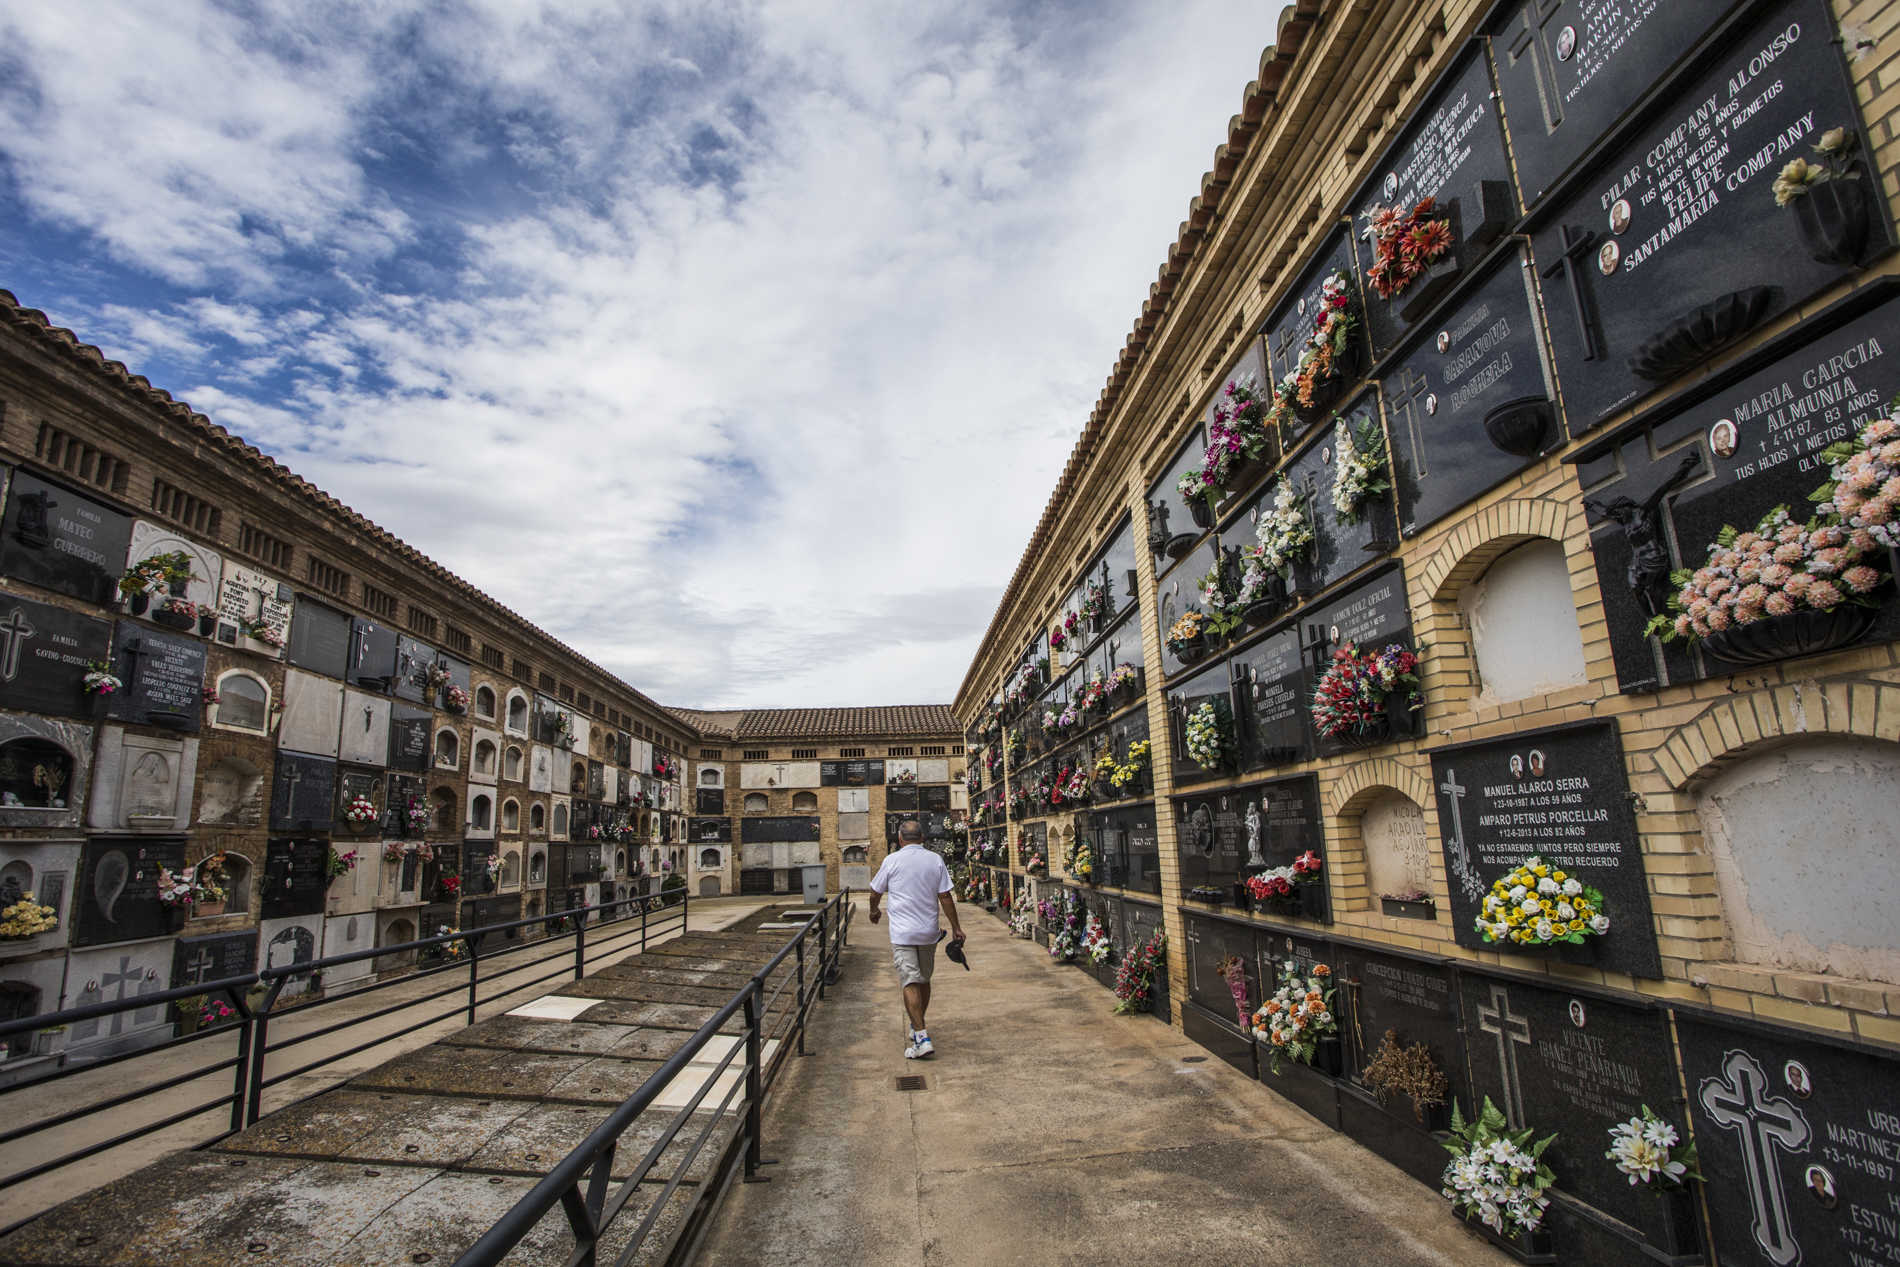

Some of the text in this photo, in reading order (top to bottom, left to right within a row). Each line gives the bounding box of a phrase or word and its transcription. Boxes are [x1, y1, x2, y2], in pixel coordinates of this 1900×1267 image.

[1413, 107, 1445, 154] ANTONIO
[1600, 23, 1800, 210] PILAR COMPANY ALONSO
[1697, 123, 1711, 140] 96
[1399, 133, 1438, 190] ANASTASIO
[1401, 188, 1415, 210] ANA
[1444, 103, 1485, 158] MACHUCA
[1640, 79, 1784, 207] TUS HIJOS NIETOS Y BIZNIETOS
[1624, 110, 1815, 272] SANTAMARIA COMPANY
[1661, 142, 1730, 206] NO TE OLVIDAN
[1667, 162, 1725, 219] FELIPE
[1443, 317, 1511, 384] CASANOVA
[1734, 337, 1883, 425] MARIA GARCIA
[1767, 376, 1858, 433] ALMUNIA
[1824, 406, 1841, 424] 83
[1847, 389, 1880, 414] AÑOS
[1735, 463, 1755, 481] TUS
[1758, 448, 1789, 471] HIJOS
[1793, 442, 1800, 455] Y
[1806, 423, 1847, 450] NIETOS
[54, 537, 106, 566] GUERRERO
[58, 516, 94, 540] MATEO
[1484, 776, 1590, 797] MANUEL ALARCO SERRA
[1531, 797, 1536, 806] A
[1536, 795, 1550, 805] LOS
[1562, 792, 1582, 804] AÑOS
[1480, 808, 1609, 826] AMPARO PETRUS PORCELLAR
[1533, 828, 1539, 837] A
[1540, 827, 1553, 837] LOS
[1565, 825, 1586, 836] AÑOS
[1477, 843, 1486, 852] YA
[1486, 843, 1496, 853] NO
[1496, 843, 1534, 853] ESTAREMOS
[1563, 843, 1585, 853] PERO
[1585, 842, 1622, 853] SIEMPRE
[1482, 855, 1496, 864] NOS
[1575, 856, 1619, 867] RECUERDO
[1562, 1028, 1607, 1056] VICENTE
